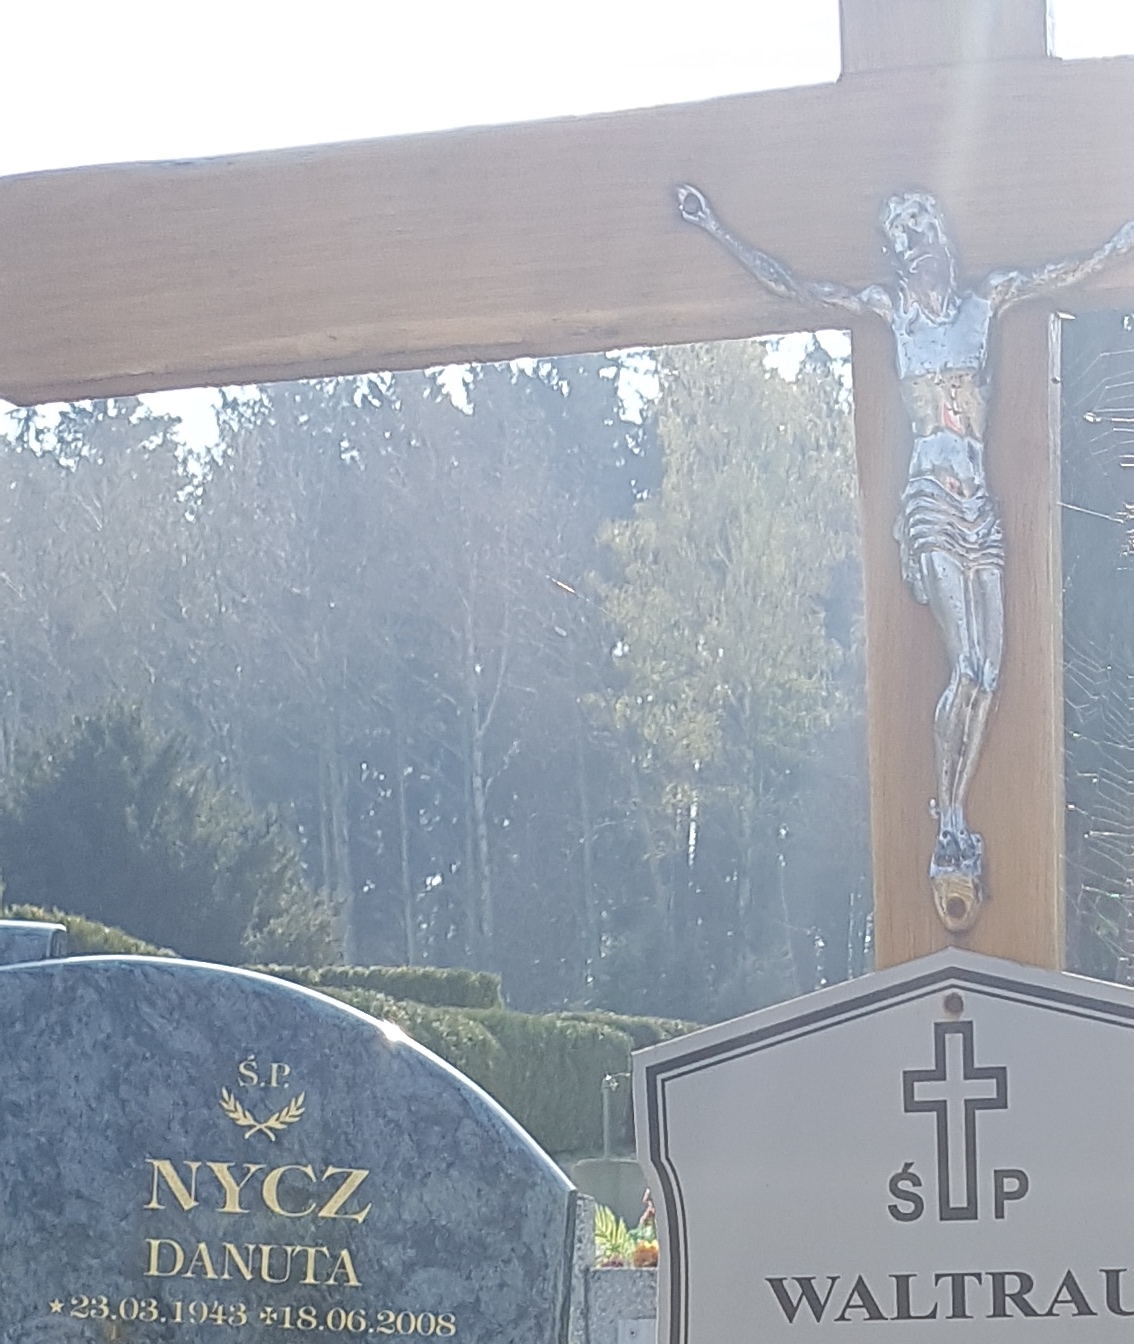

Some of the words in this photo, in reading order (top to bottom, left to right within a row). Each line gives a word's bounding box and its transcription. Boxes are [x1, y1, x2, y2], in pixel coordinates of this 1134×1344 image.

[143, 1158, 372, 1224] NYCZ
[887, 1161, 925, 1223] Ś
[993, 1168, 1029, 1220] P
[143, 1238, 363, 1287] DANUTA
